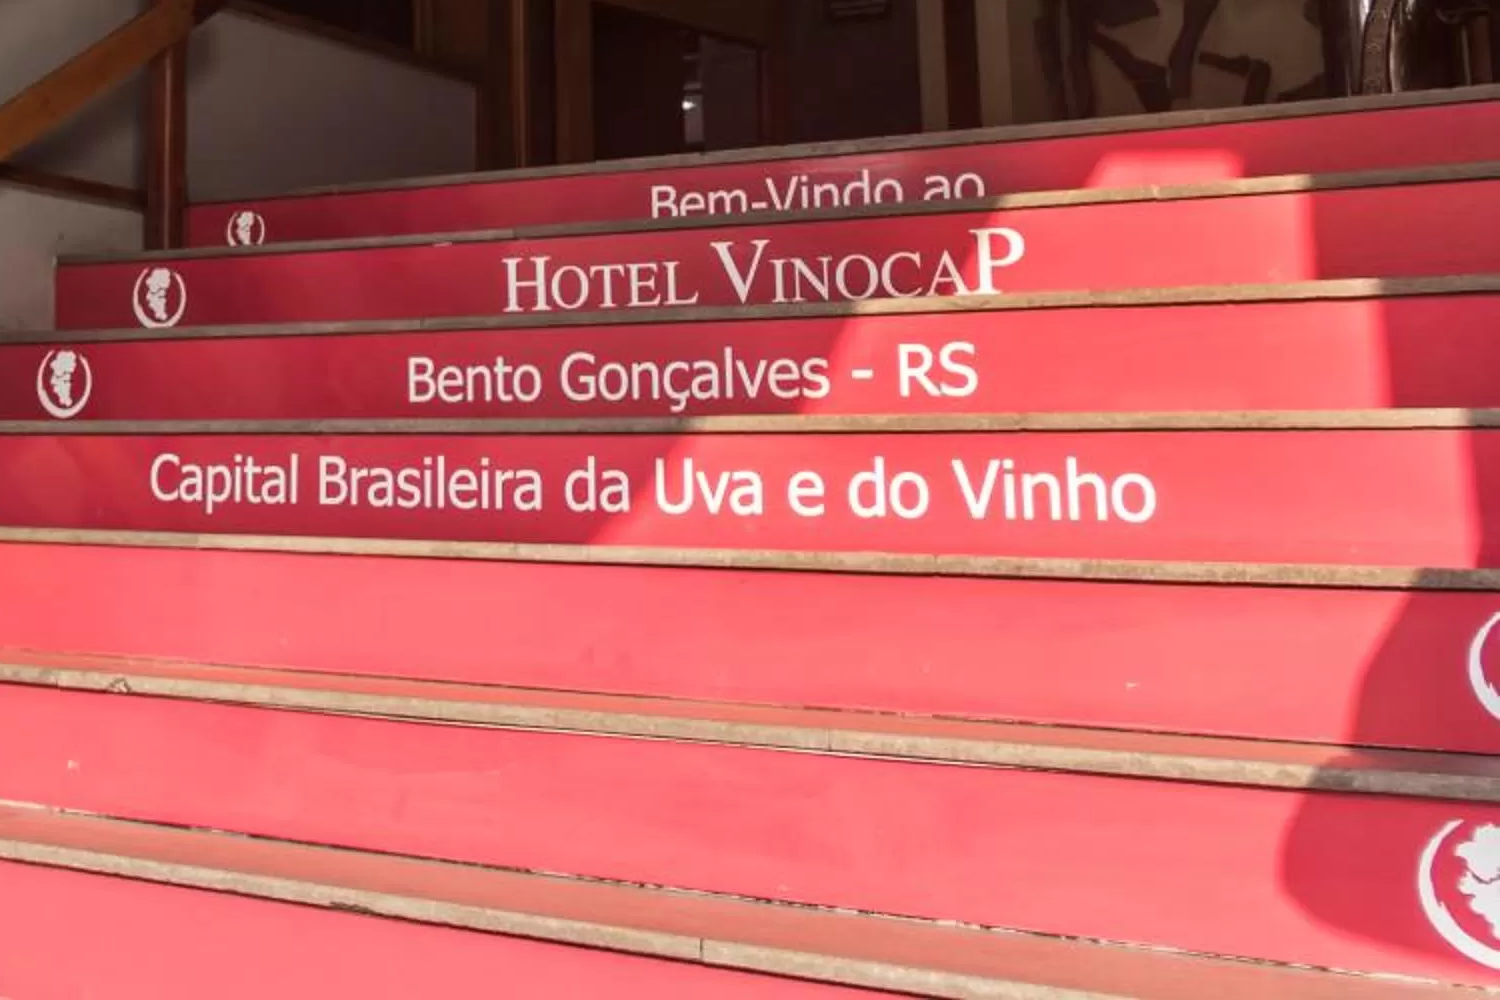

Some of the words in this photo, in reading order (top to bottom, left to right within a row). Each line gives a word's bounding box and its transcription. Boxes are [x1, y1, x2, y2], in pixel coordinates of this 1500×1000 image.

[651, 168, 904, 219] Bem-Vindo
[923, 172, 986, 201] ao
[406, 355, 543, 404] Bento
[560, 346, 831, 412] Gonçalves
[898, 341, 979, 398] RS
[149, 453, 299, 515] Capital
[318, 455, 543, 512] Brasileira
[563, 455, 631, 514] da
[655, 457, 764, 517] Uva
[786, 470, 826, 518] e
[847, 455, 930, 520] do
[950, 455, 1158, 524] Vinho
